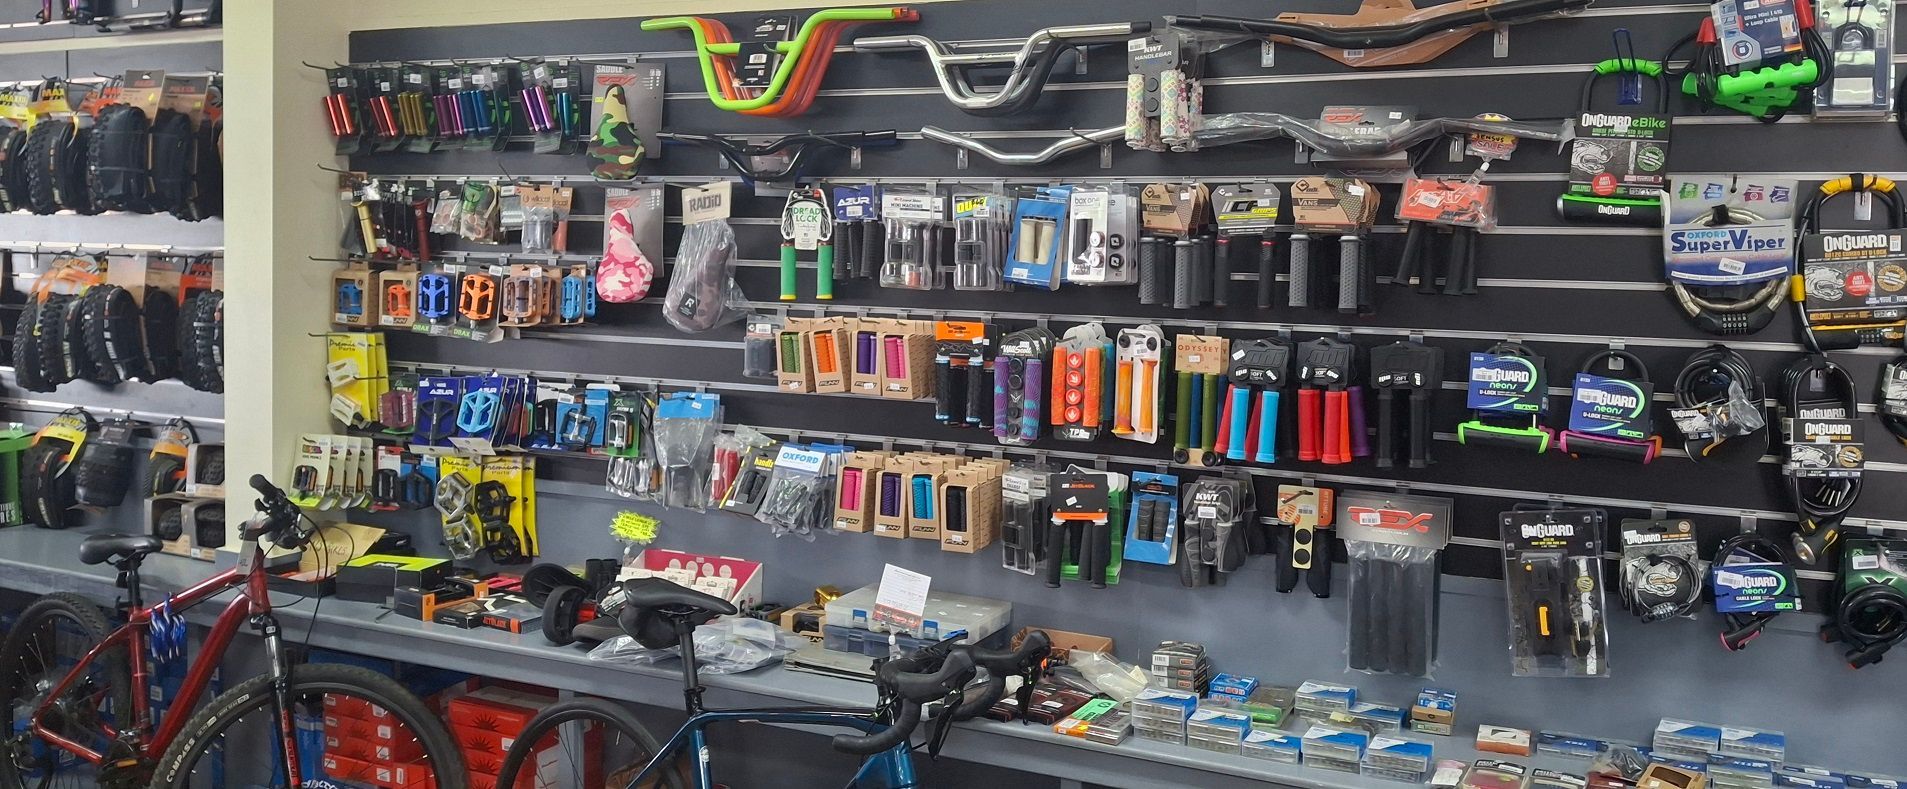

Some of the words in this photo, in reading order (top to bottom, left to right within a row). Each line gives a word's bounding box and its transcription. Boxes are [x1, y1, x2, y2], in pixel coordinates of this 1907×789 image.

[1134, 50, 1172, 61] HANDLEBAR
[1632, 117, 1666, 129] eBike
[837, 196, 870, 207] AZUR
[1687, 231, 1727, 239] OXFORD
[782, 452, 819, 464] OXFORD
[1195, 492, 1219, 501] KWT
[166, 738, 196, 782] COMPASS
